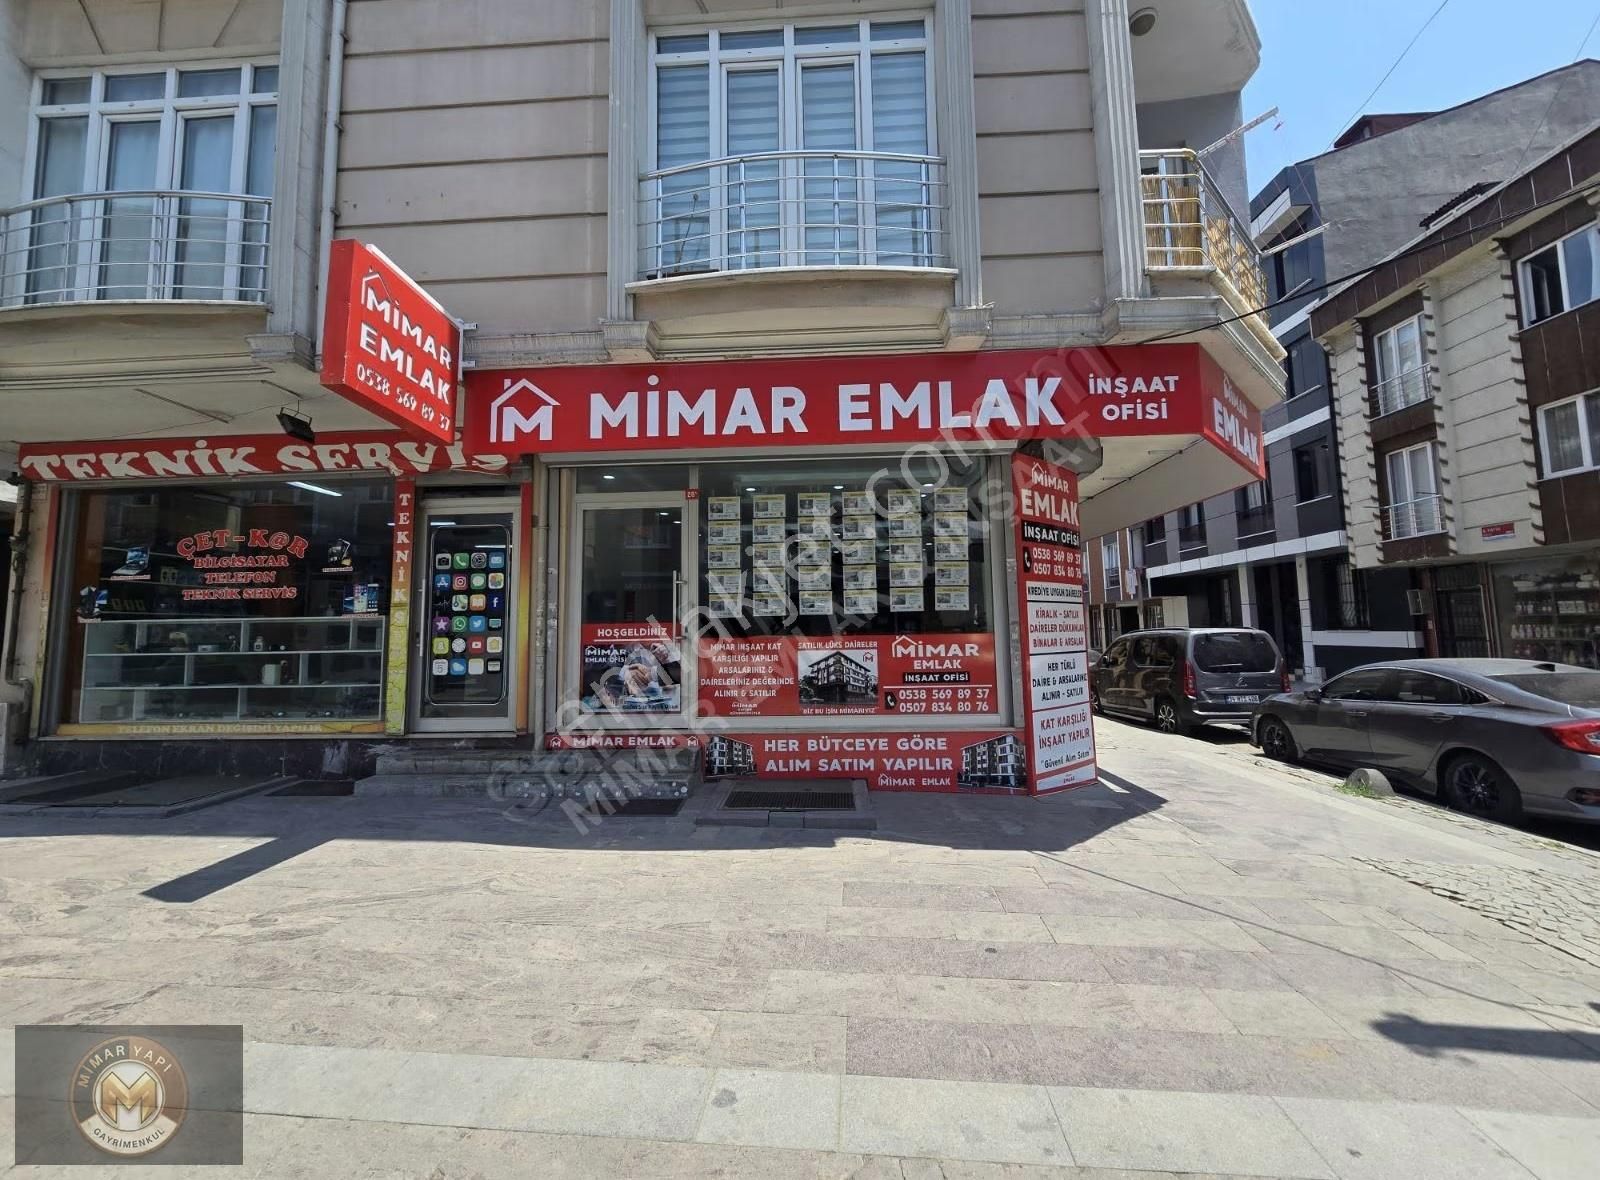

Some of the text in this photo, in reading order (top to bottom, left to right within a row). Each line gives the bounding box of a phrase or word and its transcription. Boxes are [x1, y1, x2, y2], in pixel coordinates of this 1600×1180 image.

[367, 287, 452, 371] MİMAR
[360, 322, 450, 404] EMLAK
[356, 363, 390, 396] 0538
[396, 387, 417, 411] 569
[421, 401, 435, 422] 89
[1088, 373, 1179, 398] İNŞAAT
[590, 375, 1066, 439] MİMAR EMLAK
[1102, 398, 1168, 421] OFİSİ
[1213, 397, 1260, 465] EMLAK
[20, 440, 268, 481] TEKNİK
[1033, 470, 1069, 494] MİMAR
[1021, 488, 1080, 526] EMLAK
[1024, 522, 1080, 547] İNŞAAT OFİSİ
[396, 493, 411, 601] TEKNİK
[1032, 547, 1051, 561] 0538
[194, 553, 290, 568] BİLGİSAYAR
[1033, 561, 1051, 575] 0507
[205, 571, 277, 584] TELEFON
[182, 585, 297, 600] TEKNİK SERVİS
[597, 626, 668, 639] HOŞGELDİNİZ
[587, 647, 626, 656] MİMAR
[767, 642, 782, 650] KAT
[798, 640, 878, 649] SATILIK LÜKS DAİRELER
[896, 640, 980, 658] MİMAR
[750, 654, 779, 662] YAPILIR
[913, 659, 962, 670] EMLAK
[1048, 661, 1059, 672] HER
[905, 673, 969, 683] İNŞAAT OFİSİ
[1032, 676, 1050, 688] DAİRE
[899, 689, 990, 699] 0538 569 89 37
[899, 702, 989, 712] 0507 834 80 76
[1041, 718, 1055, 731] KAT
[573, 735, 676, 746] MİMAR EMLAK
[764, 739, 799, 752] HER
[896, 734, 947, 750] GÖRE
[1038, 733, 1066, 751] İNŞAAT
[765, 757, 953, 772] ALIM SATIM YAPILIR
[880, 775, 951, 787] MİMAR EMLAK
